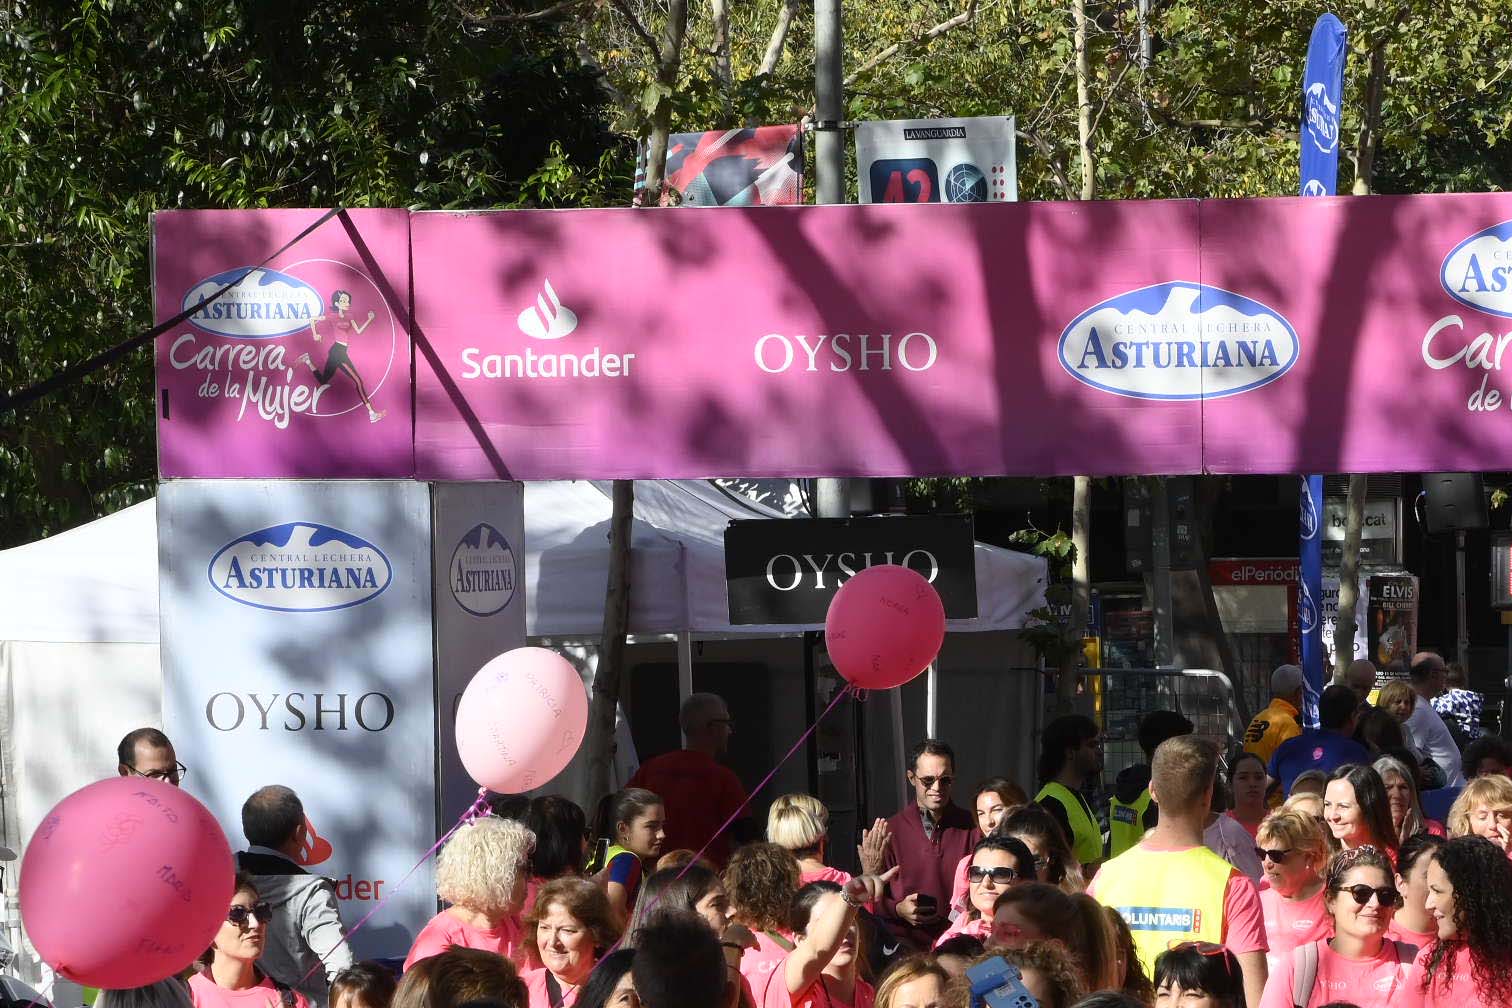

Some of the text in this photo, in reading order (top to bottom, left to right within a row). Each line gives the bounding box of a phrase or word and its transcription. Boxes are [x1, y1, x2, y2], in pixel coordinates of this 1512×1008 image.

[192, 292, 312, 320] ASTURIANA
[1114, 322, 1186, 336] CENTRAL
[169, 333, 286, 371] Carrera
[461, 345, 635, 380] Santander
[753, 332, 938, 373] OYSHO
[1076, 325, 1280, 370] ASTURIANA
[198, 371, 240, 398] de la
[238, 367, 331, 430] Mujer
[1467, 373, 1502, 412] de
[223, 554, 379, 590] ASTURIANA
[251, 552, 372, 563] CENTRAL LECHERA
[1231, 565, 1300, 582] elPeriódi
[455, 563, 513, 594] ASTURIANA
[1383, 586, 1413, 599] ELVIS
[205, 691, 396, 732] OYSHO
[1122, 911, 1191, 927] OLUNTARIS
